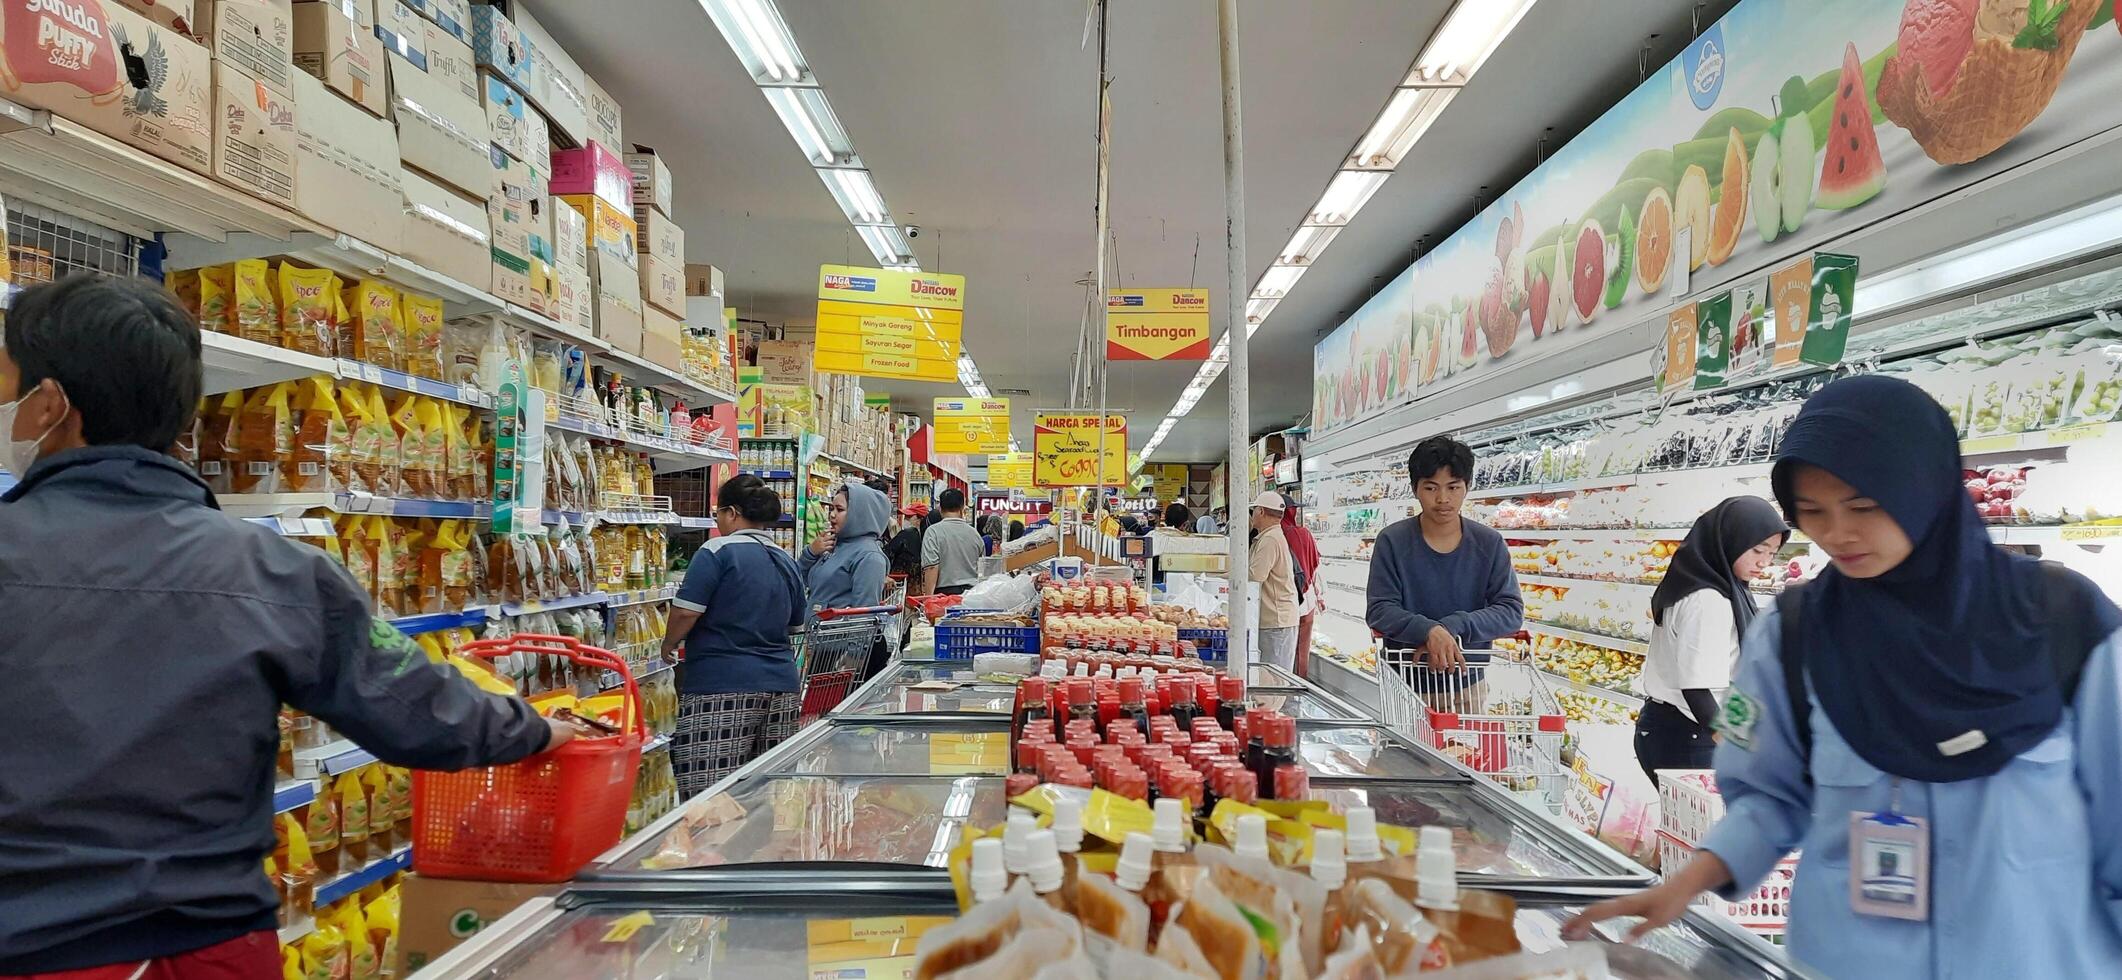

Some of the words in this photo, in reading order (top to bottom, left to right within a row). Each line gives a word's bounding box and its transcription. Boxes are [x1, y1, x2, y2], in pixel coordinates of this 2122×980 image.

[39, 15, 97, 67] PUFFY
[48, 48, 80, 71] Stick
[431, 50, 457, 76] Truffle
[825, 275, 850, 285] NAGA
[911, 279, 958, 296] Dancow
[1172, 294, 1205, 305] Dancow
[863, 320, 887, 329] Minyak
[888, 322, 913, 332] Goreng
[1115, 324, 1196, 341] Timbangan
[865, 339, 893, 348] Sayuran
[893, 341, 913, 350] Segar
[871, 358, 893, 367] Frozen
[893, 360, 910, 368] Food
[1046, 417, 1080, 429] HARGA
[1082, 417, 1121, 429] SPEIAL
